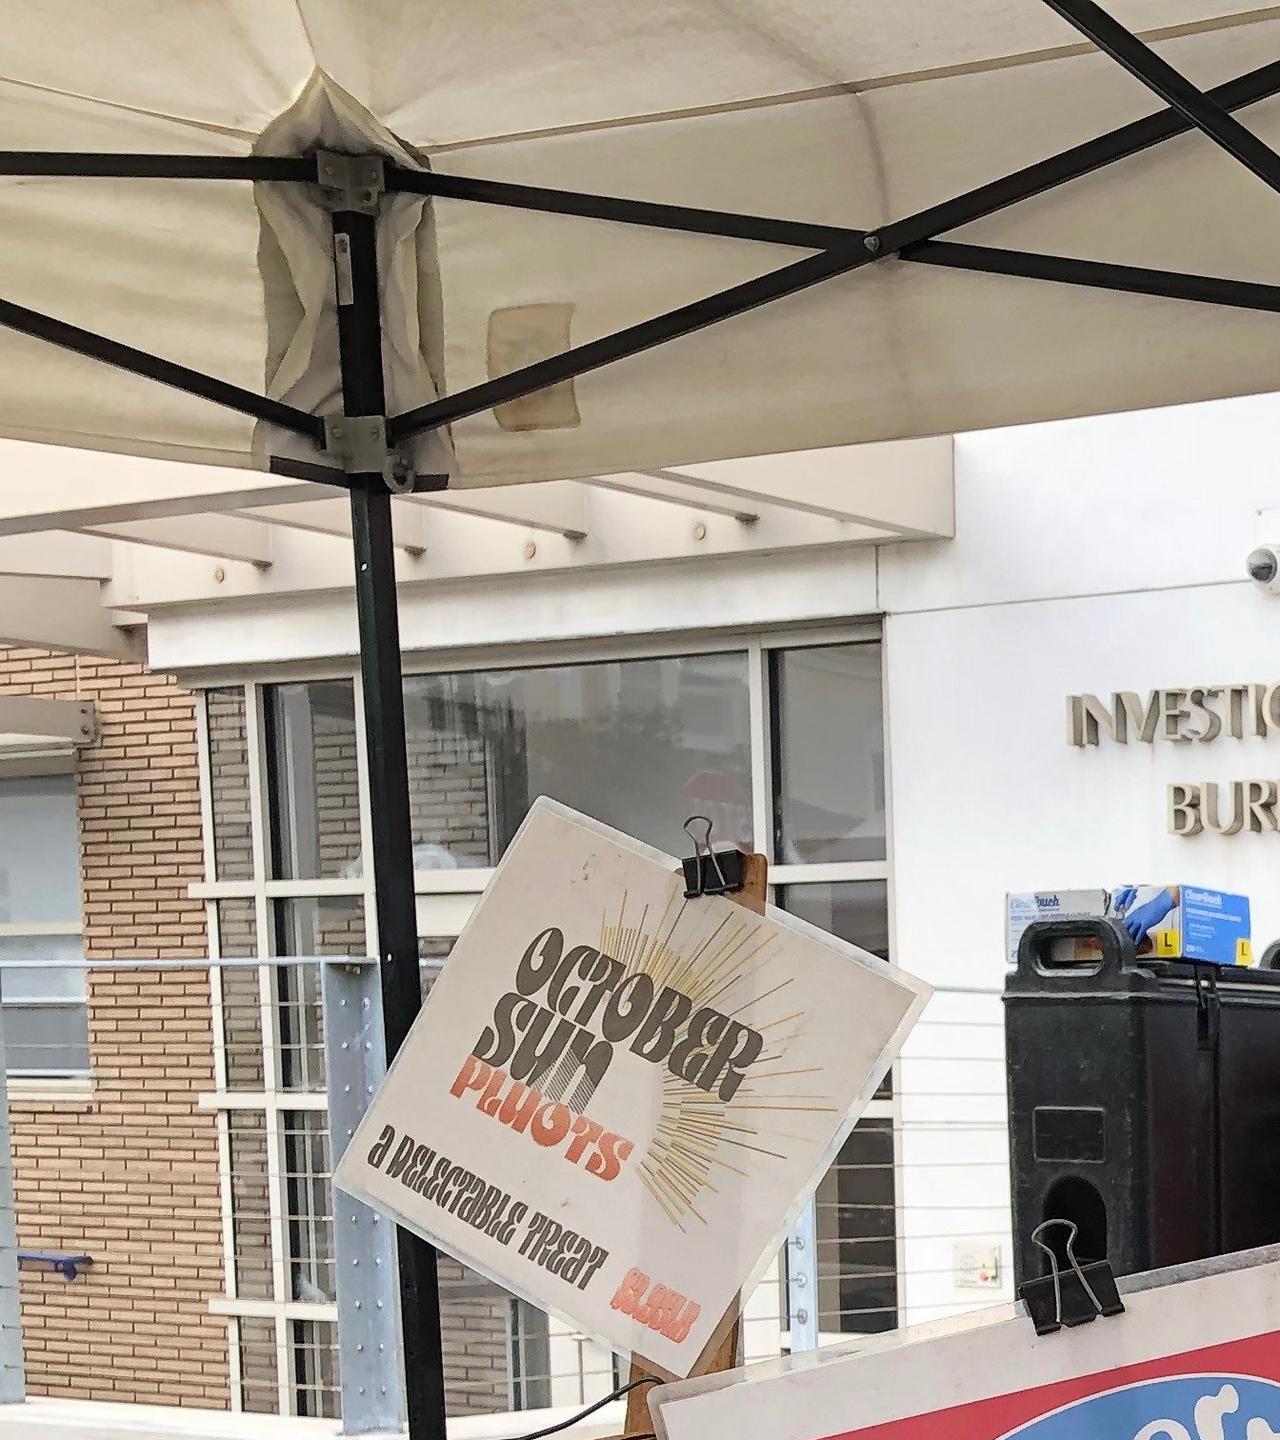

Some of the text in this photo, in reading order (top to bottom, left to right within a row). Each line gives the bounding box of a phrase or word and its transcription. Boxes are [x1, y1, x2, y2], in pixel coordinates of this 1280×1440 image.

[1164, 932, 1172, 947] L
[1241, 941, 1248, 956] L
[516, 927, 764, 1102] OCTOBER
[450, 1054, 635, 1182] PLUOTS
[386, 1135, 529, 1245] DELECTABLE
[518, 1212, 610, 1290] TREAT
